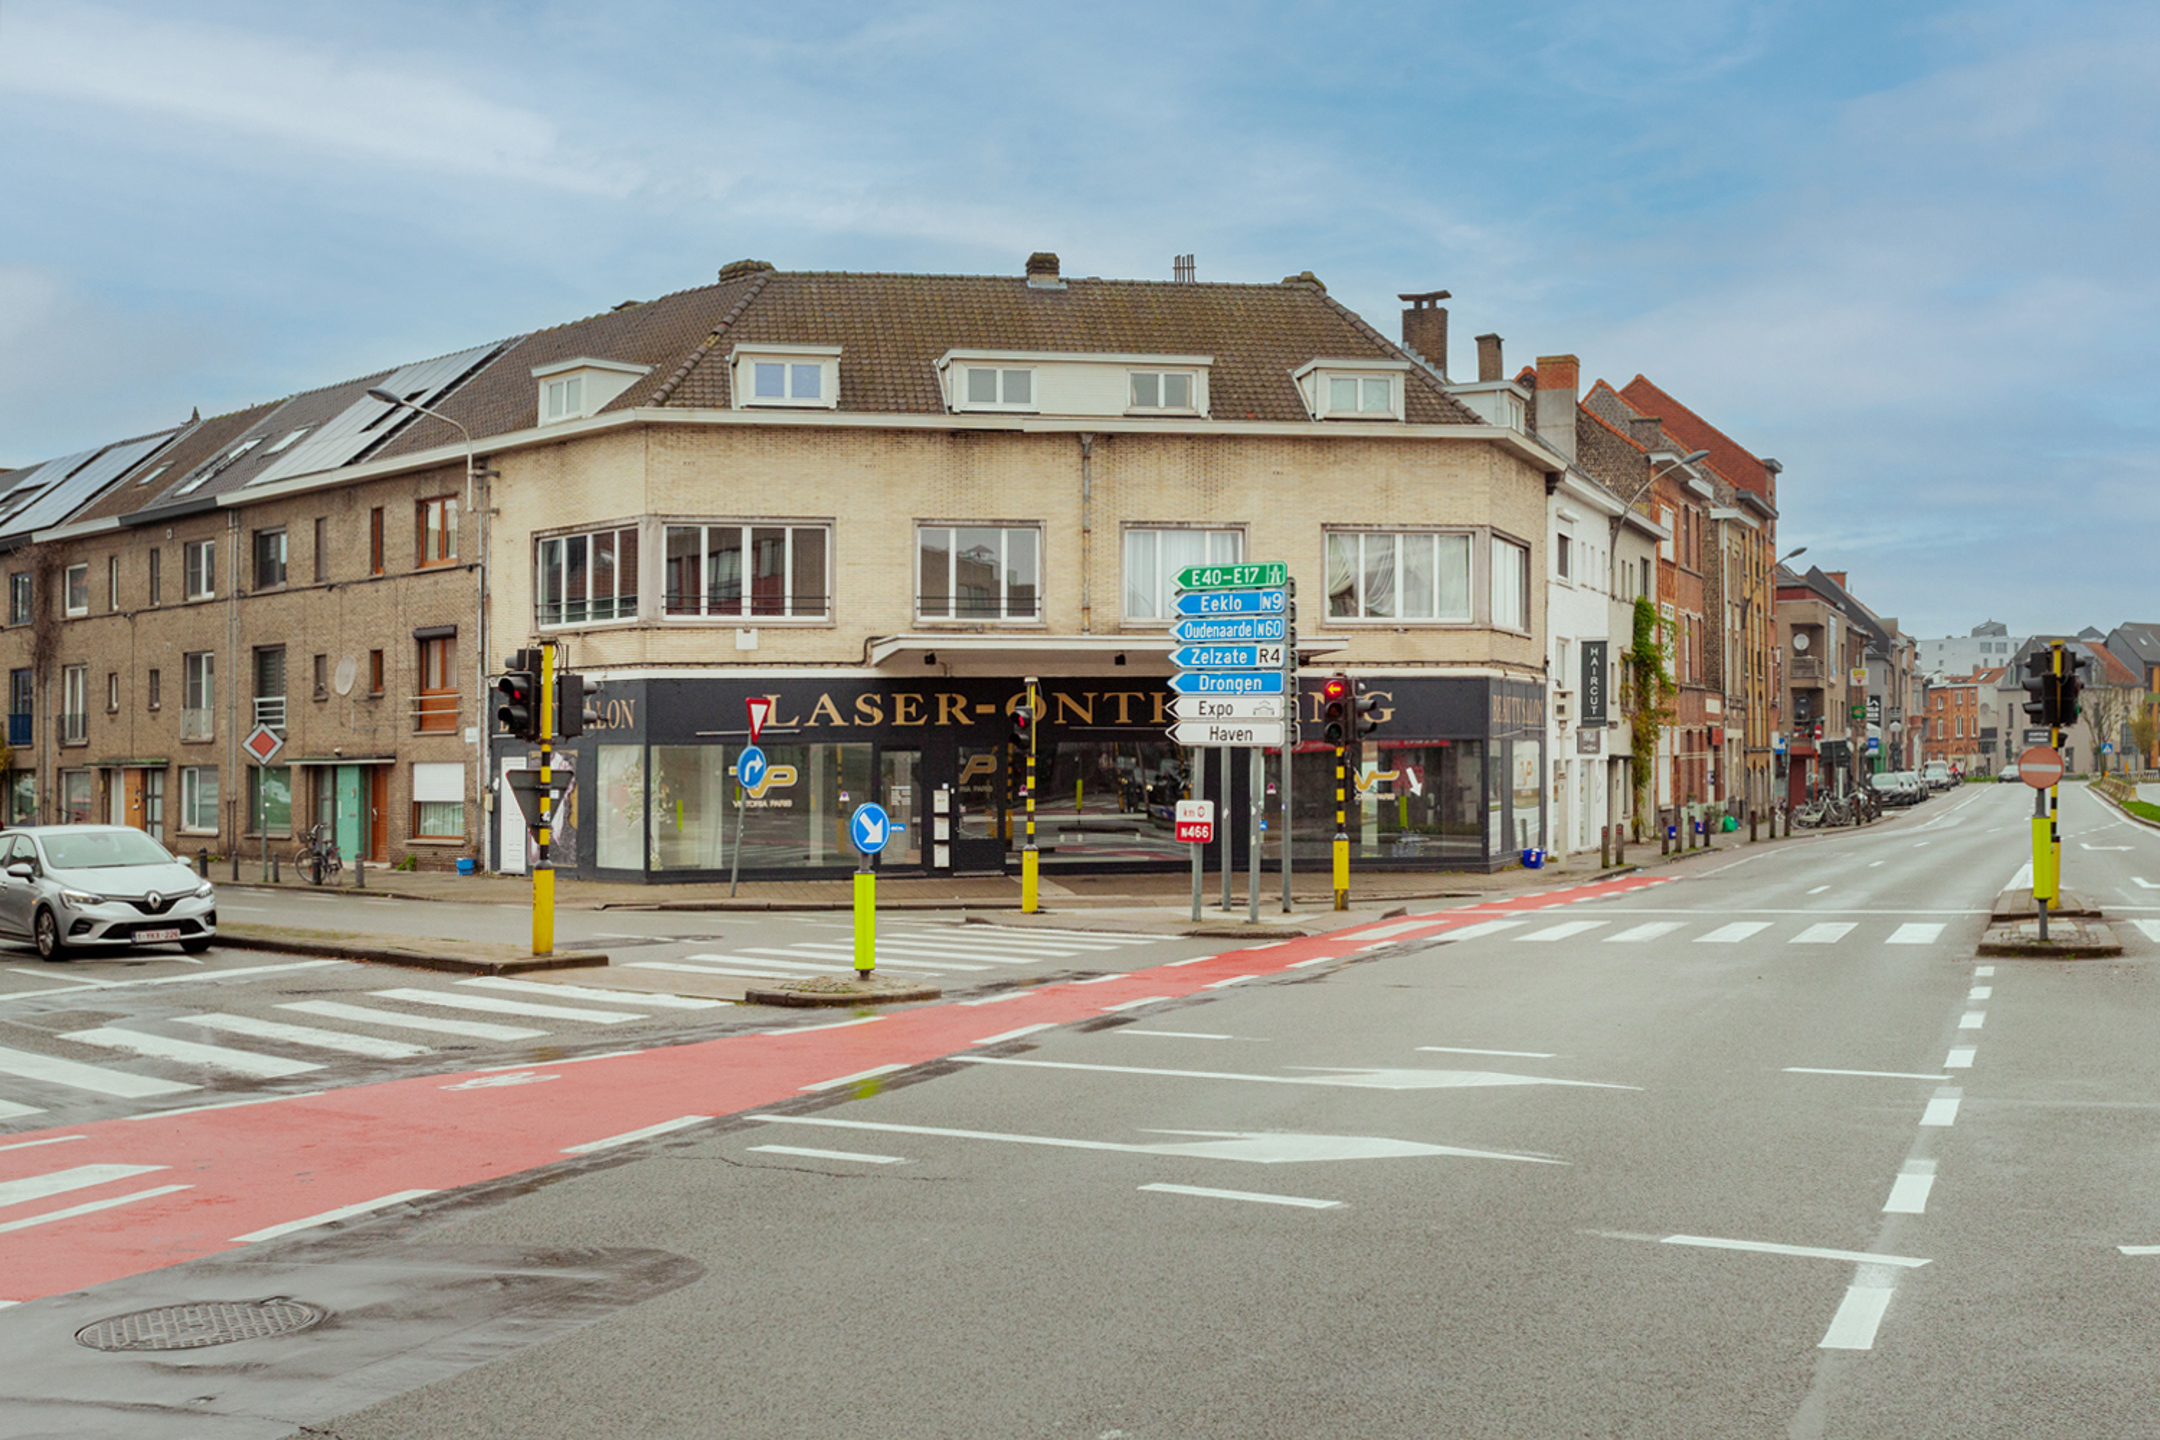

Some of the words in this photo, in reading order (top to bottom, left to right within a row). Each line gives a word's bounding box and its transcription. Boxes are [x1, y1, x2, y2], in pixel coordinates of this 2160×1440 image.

[1191, 566, 1260, 586] E40-E17
[1200, 595, 1242, 612] Eeklo
[1262, 592, 1283, 610] N9
[1184, 620, 1252, 639] Oudenaarde
[1257, 619, 1282, 637] N60
[1191, 648, 1248, 665] Zelzate
[1259, 647, 1281, 664] R4
[1199, 674, 1262, 694] Drongen
[1590, 647, 1599, 715] HAIRCUT
[1198, 700, 1234, 719] Expo
[1209, 725, 1254, 742] Haven
[1183, 807, 1195, 818] km
[1197, 805, 1205, 818] 0
[1180, 825, 1209, 839] N466
